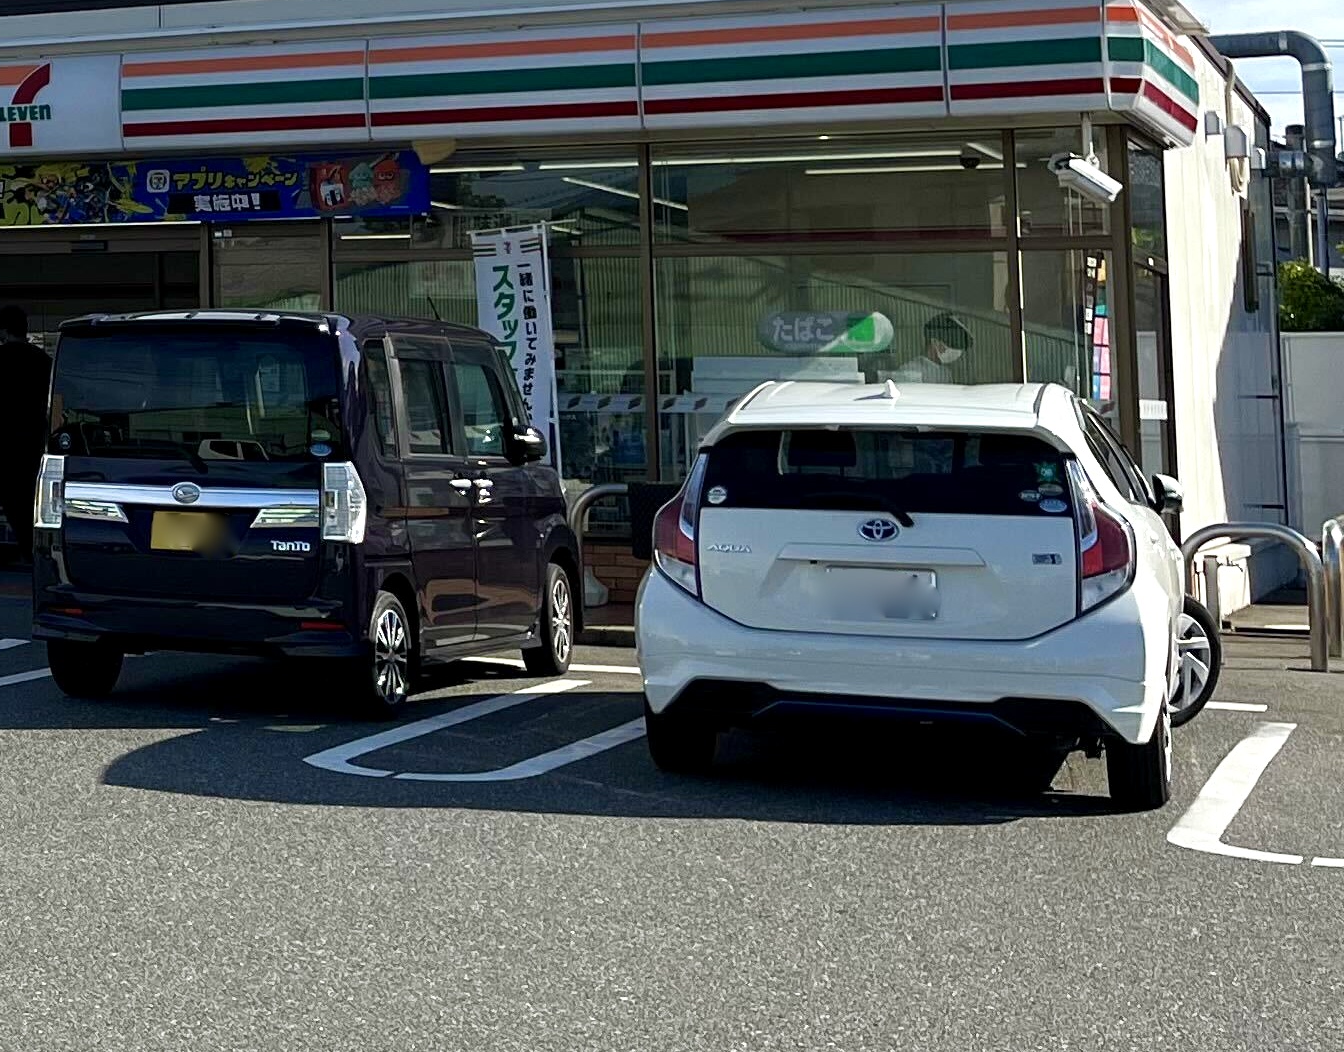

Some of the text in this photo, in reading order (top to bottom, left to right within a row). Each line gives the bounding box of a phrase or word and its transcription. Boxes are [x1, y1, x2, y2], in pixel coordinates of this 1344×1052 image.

[172, 166, 299, 190] アプリキャンペーン
[492, 264, 520, 370] スタッフ
[773, 316, 834, 342] たばこ
[516, 263, 539, 421] 一緒に働いてみません
[706, 543, 752, 554] AQUA
